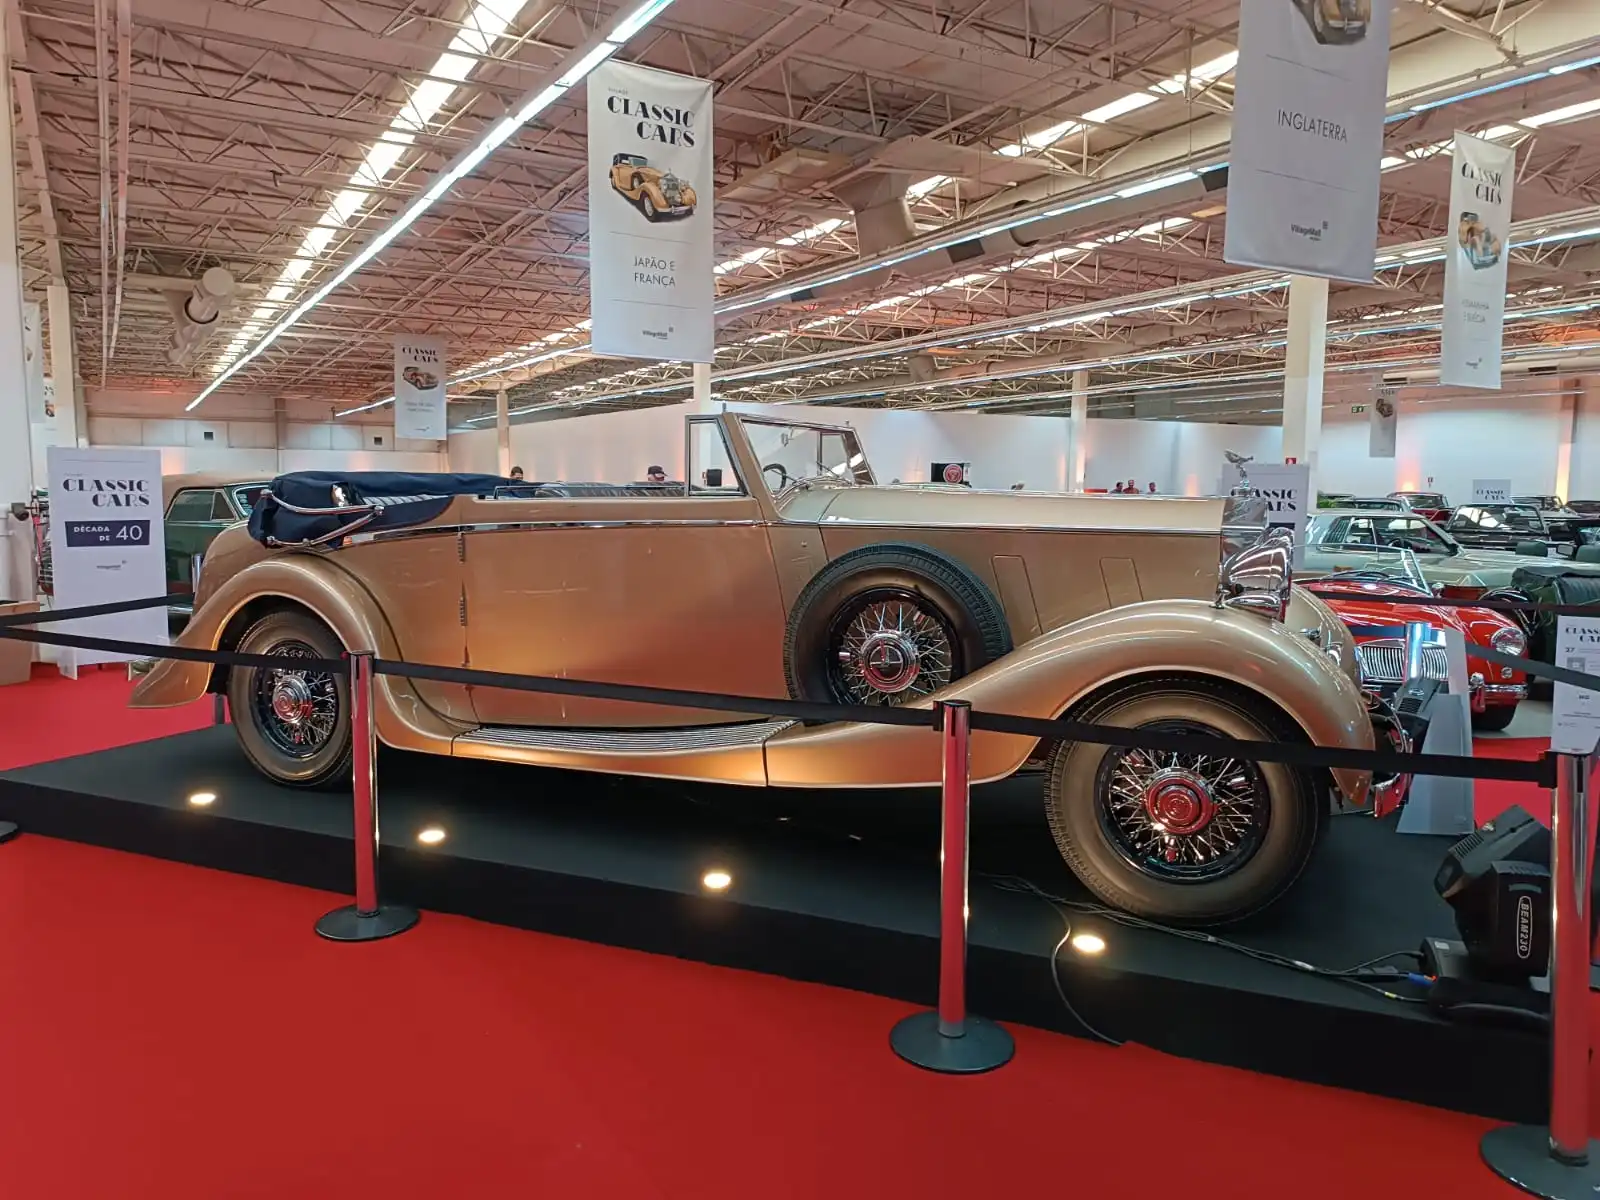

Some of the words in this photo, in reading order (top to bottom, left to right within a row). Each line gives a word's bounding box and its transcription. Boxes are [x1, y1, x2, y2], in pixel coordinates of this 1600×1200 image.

[607, 95, 695, 128] CLASSIC
[636, 121, 695, 148] CARS
[1277, 108, 1348, 144] INGLATERRA
[633, 255, 667, 270] JAPÃO
[669, 260, 676, 271] E
[633, 271, 676, 289] FRANÇA
[62, 479, 149, 492] CLASSIC
[91, 493, 150, 507] CARS
[115, 525, 143, 541] 40
[1520, 903, 1529, 951] BEAM230
